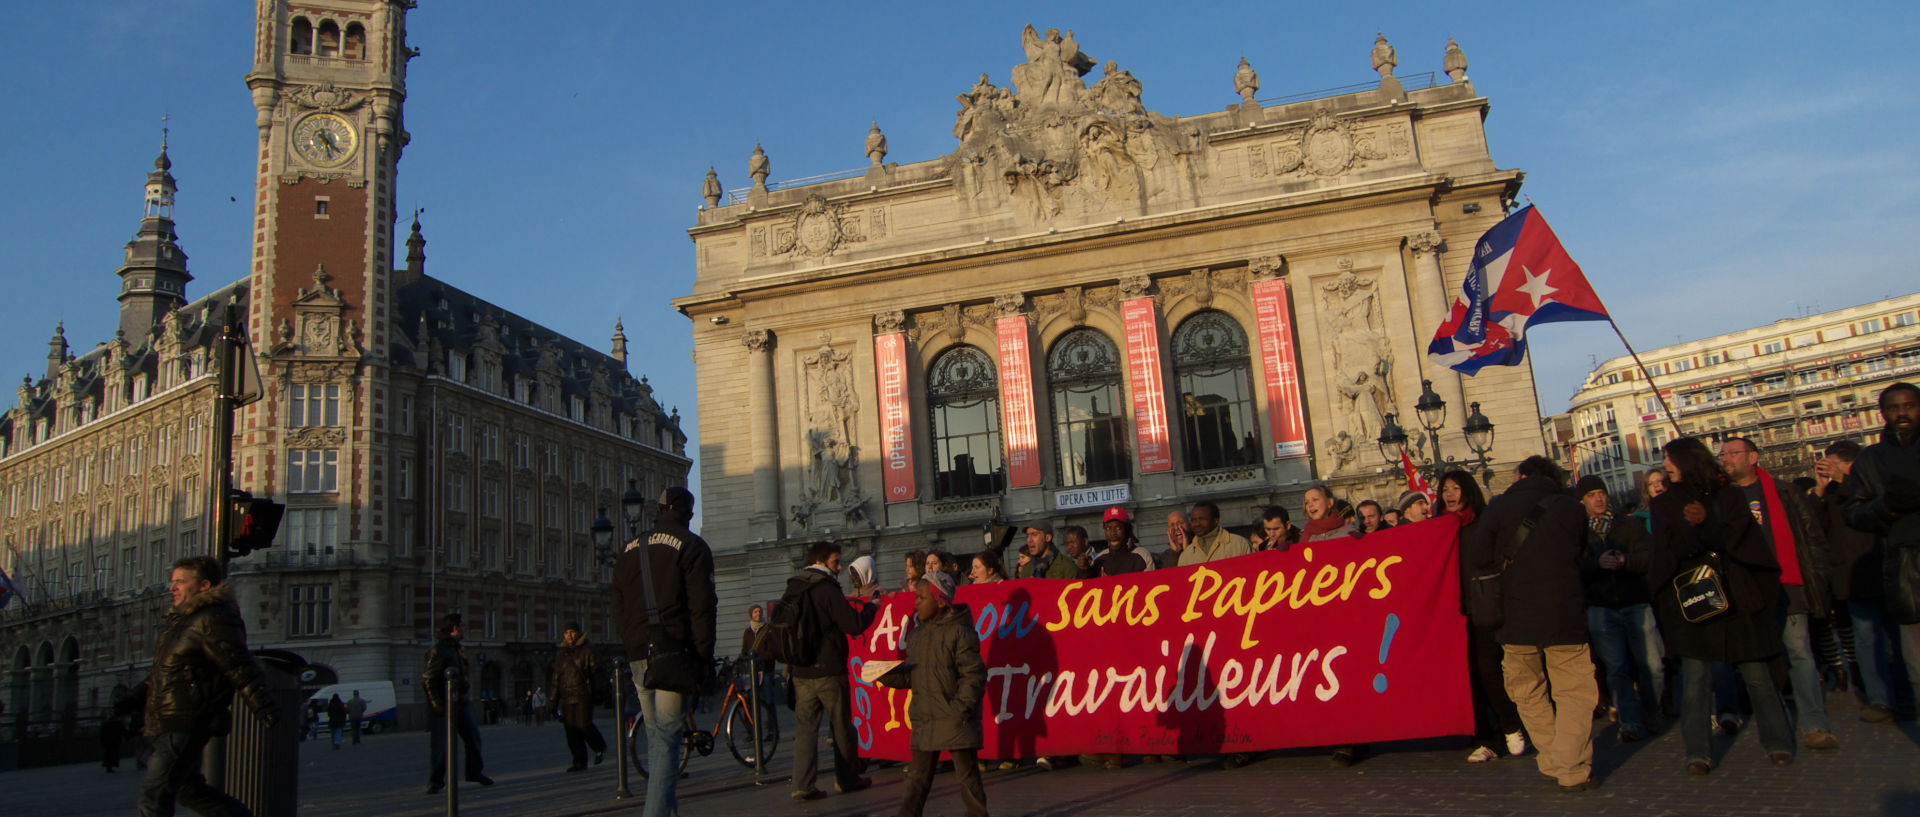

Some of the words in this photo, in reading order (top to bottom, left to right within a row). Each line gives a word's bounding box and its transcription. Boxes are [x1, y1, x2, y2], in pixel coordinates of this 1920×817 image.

[884, 339, 897, 350] 08
[884, 358, 901, 399] LILLE
[887, 400, 903, 419] DE
[888, 423, 906, 471] OPERA
[893, 485, 907, 495] 09
[1059, 493, 1085, 506] OPERA
[1087, 491, 1098, 503] EN
[1102, 488, 1125, 502] LUTTE
[975, 600, 1039, 642] ou
[1046, 580, 1171, 632] Sans
[1181, 547, 1403, 650] Papiers
[1682, 594, 1706, 608] adidas
[987, 630, 1348, 725] Travailleurs
[1373, 613, 1401, 694] !
